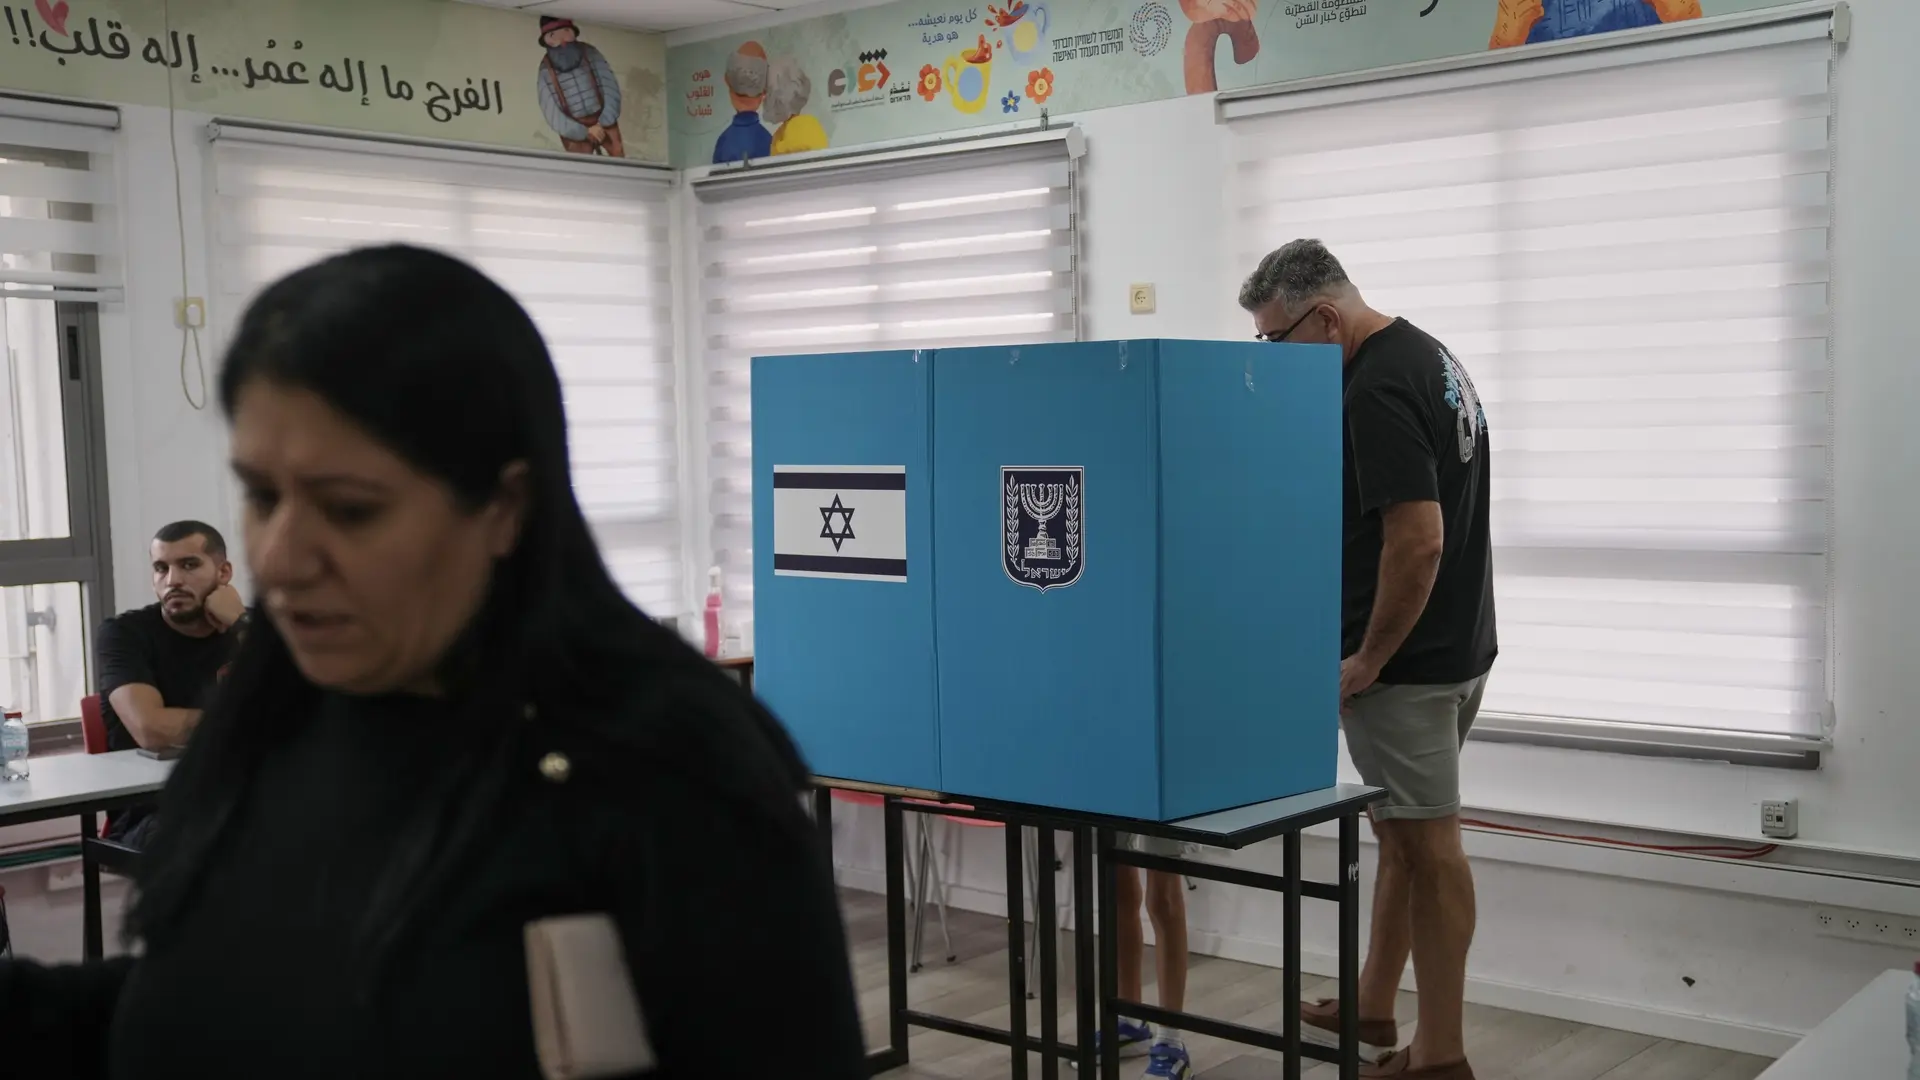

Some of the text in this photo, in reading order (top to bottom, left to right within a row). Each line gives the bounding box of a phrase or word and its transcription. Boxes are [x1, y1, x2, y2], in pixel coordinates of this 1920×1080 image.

[948, 14, 963, 24] يوم
[965, 8, 977, 23] كل
[1320, 10, 1336, 25] كبار
[922, 31, 959, 45] هو هدية
[1052, 28, 1124, 50] המשרד לשוויון חברתי
[142, 31, 201, 83] إله
[1052, 41, 1124, 63] וקידום מעמד האישה
[320, 57, 370, 106] إله
[381, 65, 413, 100] ما
[422, 78, 503, 122] الفرح
[686, 104, 712, 118] شباب
[1021, 558, 1067, 579] ישראל
